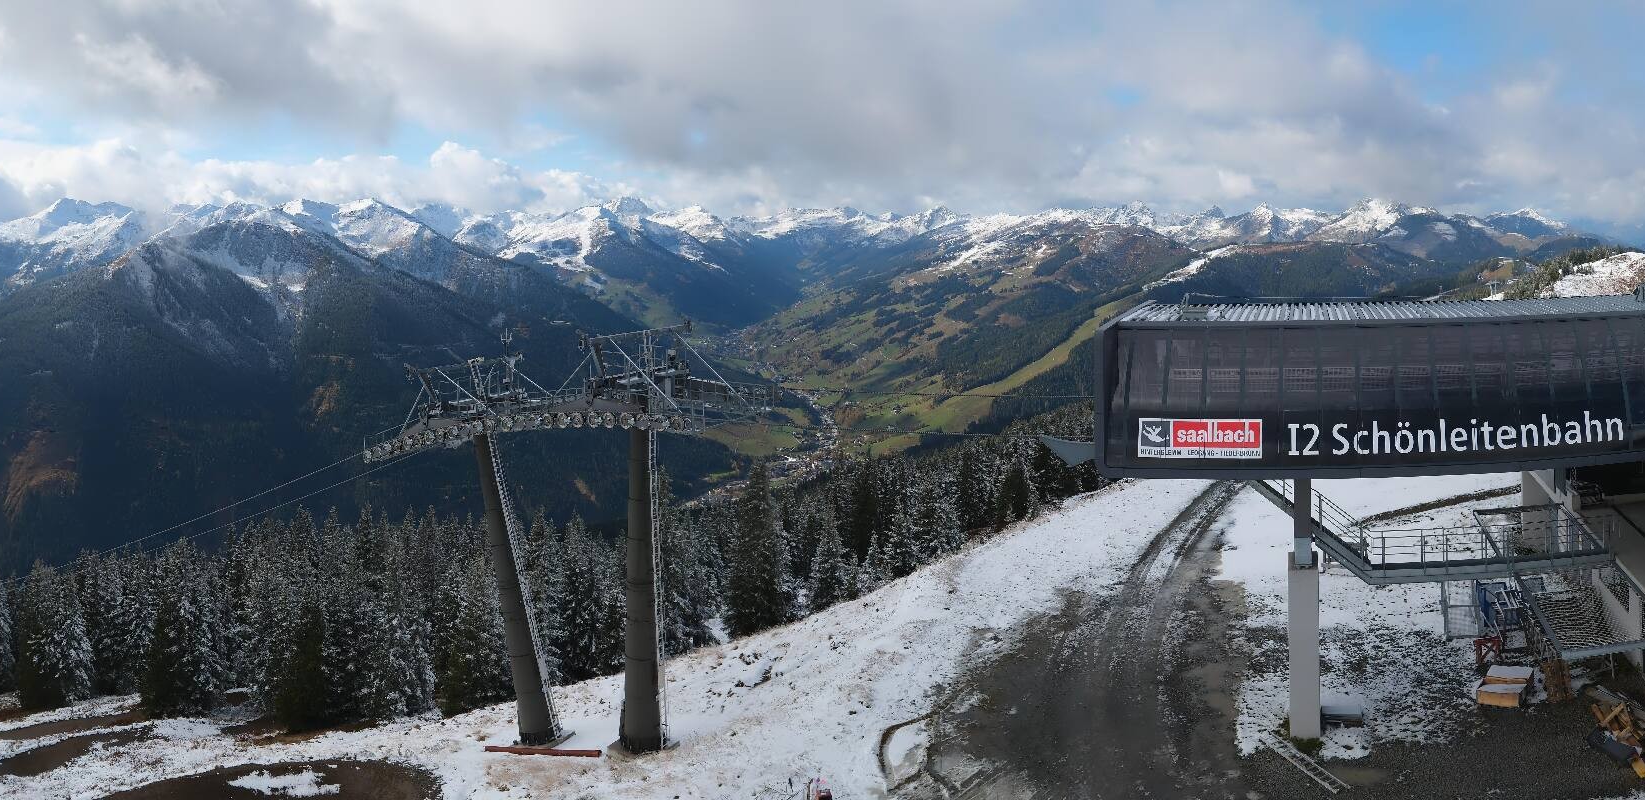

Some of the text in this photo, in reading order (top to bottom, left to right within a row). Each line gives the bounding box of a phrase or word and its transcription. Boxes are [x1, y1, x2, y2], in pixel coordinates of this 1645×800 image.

[1176, 421, 1255, 443] saalbach
[1288, 410, 1624, 456] I2 Schönleitenbahn
